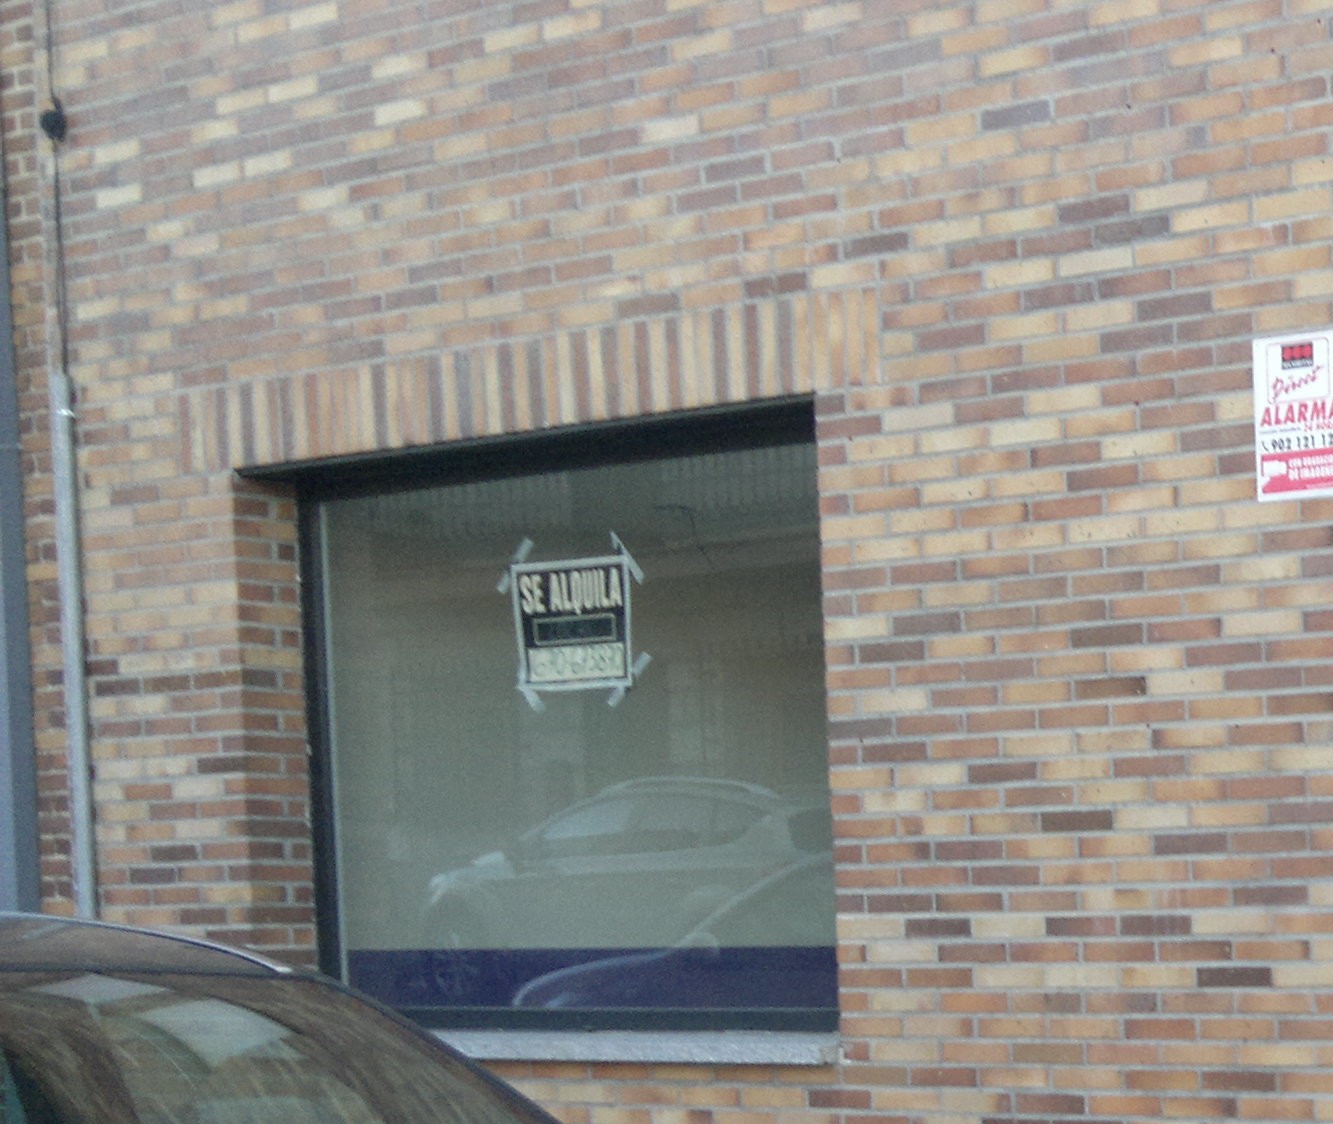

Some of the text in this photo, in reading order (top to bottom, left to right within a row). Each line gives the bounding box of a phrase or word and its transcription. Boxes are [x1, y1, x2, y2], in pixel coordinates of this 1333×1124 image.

[1271, 437, 1292, 451] 902
[1296, 434, 1316, 448] 121
[519, 566, 622, 615] SE ALQUILA
